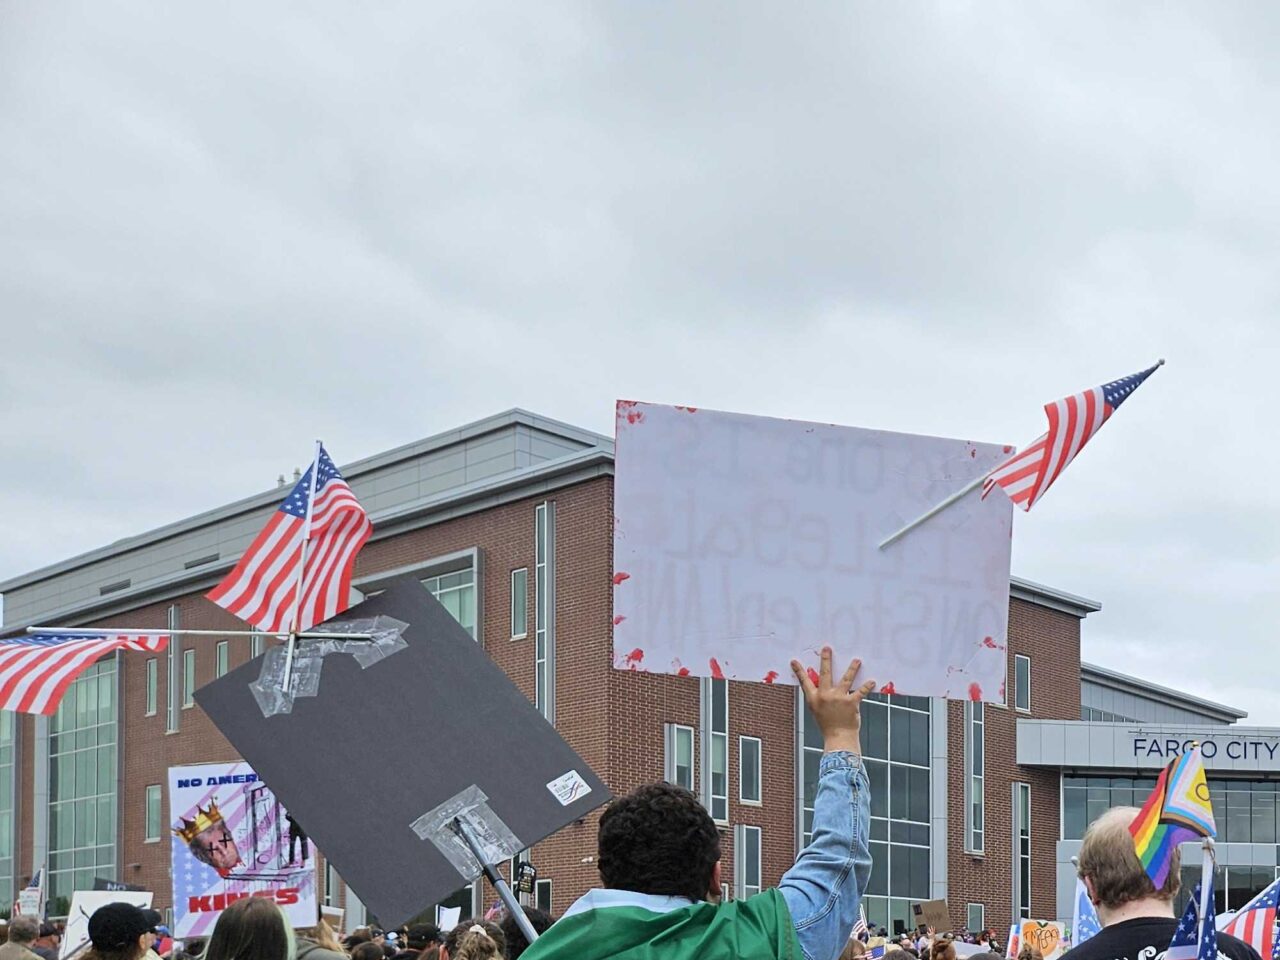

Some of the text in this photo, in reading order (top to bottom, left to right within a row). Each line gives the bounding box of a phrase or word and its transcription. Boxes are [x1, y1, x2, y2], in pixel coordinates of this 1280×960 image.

[1134, 739, 1217, 759] FARGO
[1226, 741, 1279, 760] CITY
[178, 774, 258, 788] NO AMER
